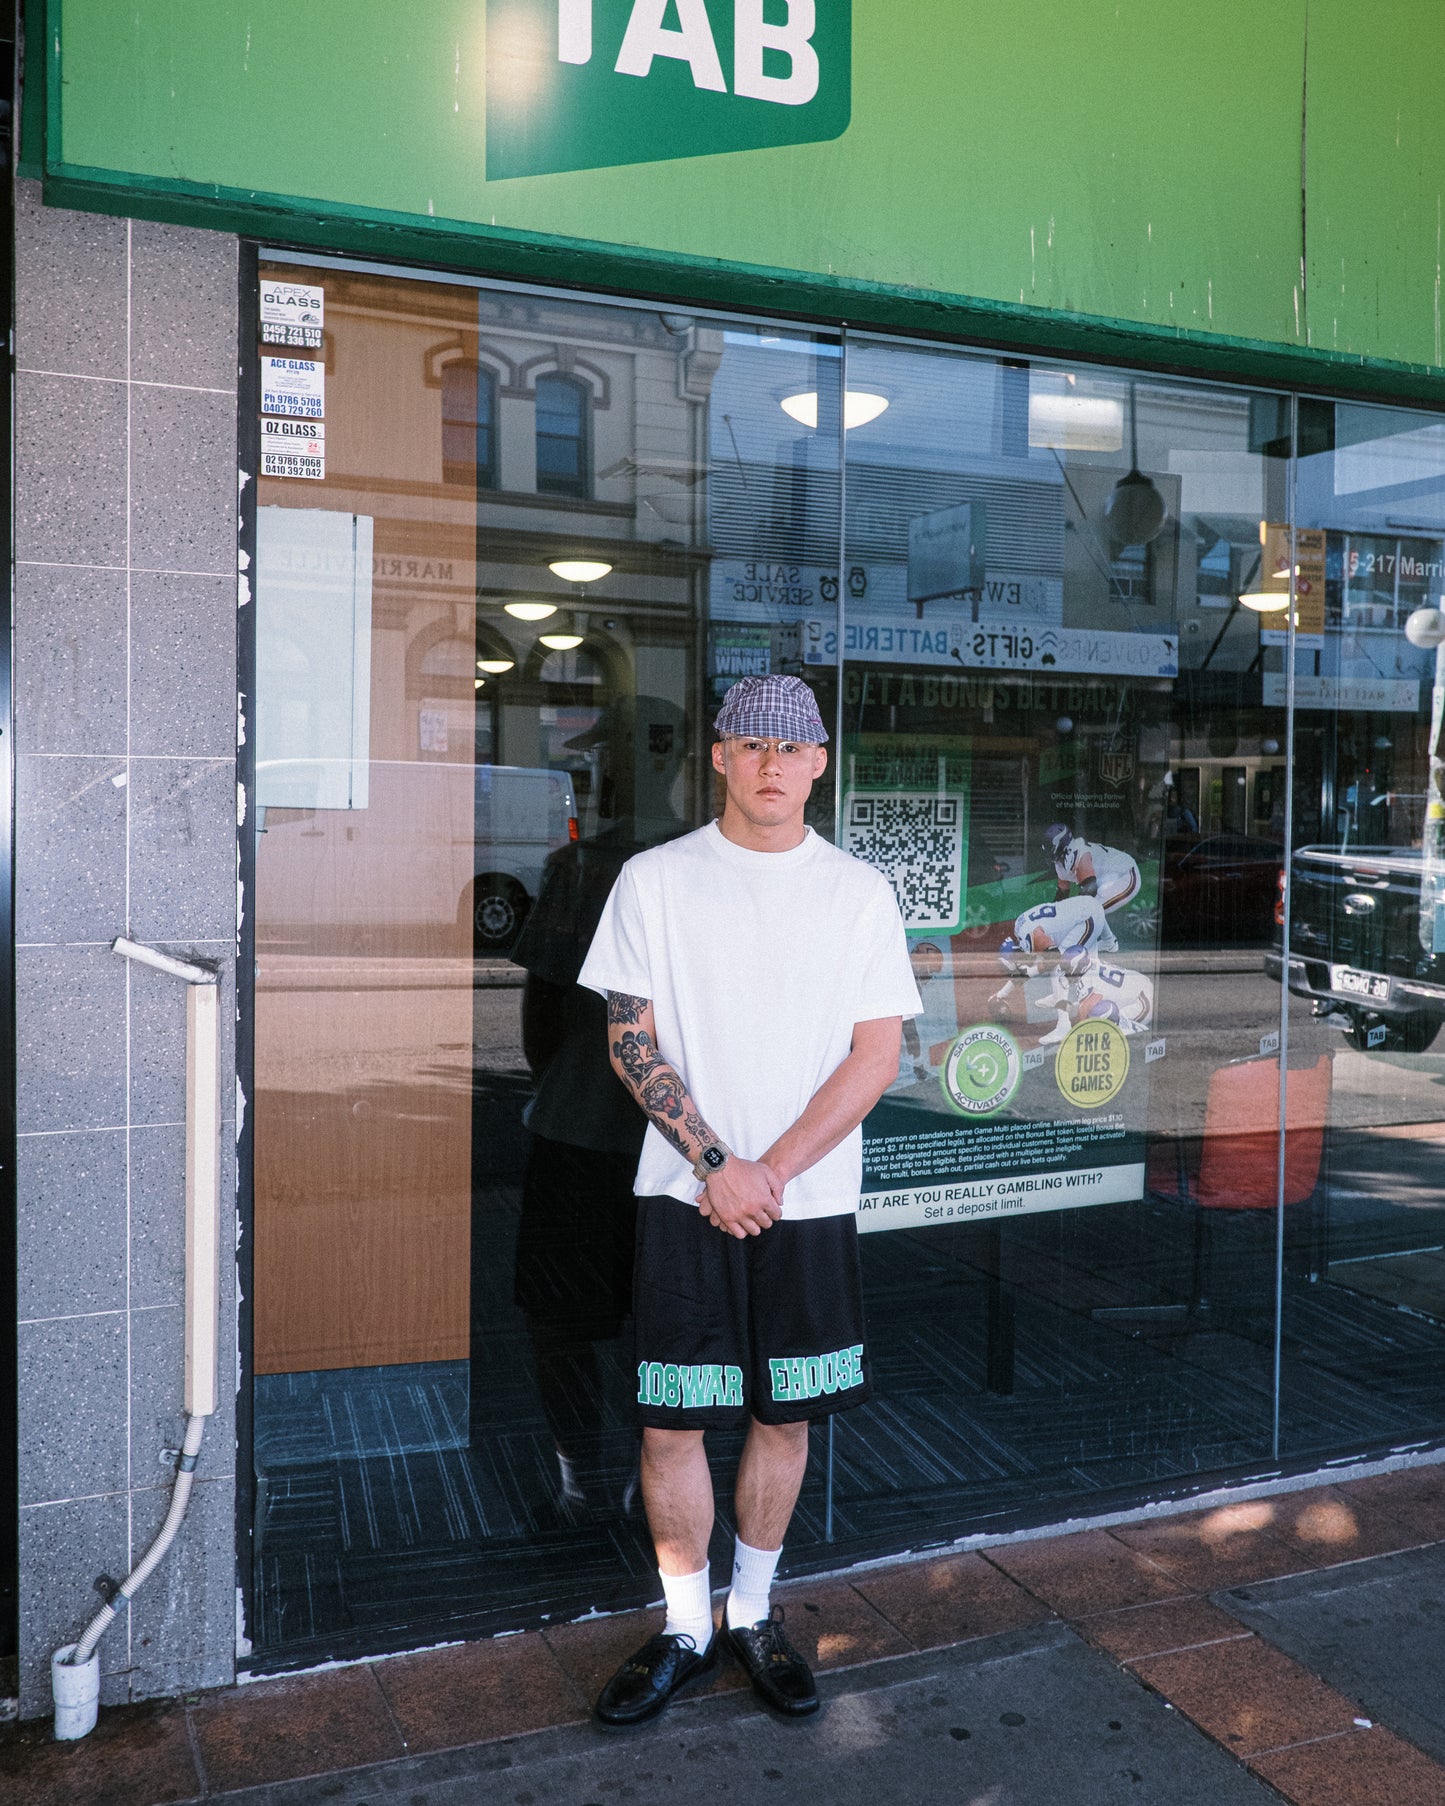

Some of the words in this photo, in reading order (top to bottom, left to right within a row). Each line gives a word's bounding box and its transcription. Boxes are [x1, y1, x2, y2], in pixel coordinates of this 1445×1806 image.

[264, 294, 320, 308] GLASS
[273, 286, 312, 298] APEX
[263, 324, 286, 334] 0456
[288, 326, 303, 336] 721
[304, 328, 321, 338] 510
[263, 333, 286, 344] 0414
[305, 338, 322, 348] 104
[271, 358, 286, 368] ACE
[289, 360, 315, 371] GLASS
[264, 394, 275, 402] Ph
[278, 395, 298, 405] 9786
[300, 397, 322, 407] 5708
[264, 403, 286, 414] 0403
[288, 406, 304, 415] 729
[306, 407, 322, 416] 260
[266, 422, 279, 434] OZ
[282, 423, 316, 437] GLASS
[266, 455, 276, 464] 02
[278, 456, 298, 466] 9786
[300, 458, 321, 468] 9068
[266, 465, 286, 474] 0410
[288, 466, 304, 476] 392
[306, 468, 322, 478] 042
[1401, 556, 1445, 578] Marri
[844, 672, 894, 705] GET
[898, 674, 917, 706] A
[923, 675, 1011, 710] BONUS
[1017, 679, 1061, 711] BET
[1068, 682, 1131, 713] BACK
[1103, 754, 1131, 777] NFL
[954, 1032, 984, 1058] SPORT
[986, 1032, 1012, 1056] SAVER
[1076, 1033, 1098, 1052] FRI
[1101, 1032, 1111, 1050] &
[1263, 1038, 1278, 1048] TAB
[1369, 1030, 1384, 1041] TAB
[1024, 1054, 1042, 1064] TAB
[1147, 1046, 1164, 1055] TAB
[1076, 1053, 1110, 1073] TUES
[1071, 1074, 1112, 1093] GAMES
[954, 1087, 1008, 1109] ACTIVATED
[869, 1146, 886, 1155] price
[905, 1142, 916, 1150] the
[917, 1139, 946, 1149] specified
[976, 1134, 1004, 1144] allocated
[1014, 1132, 1024, 1140] the
[1026, 1131, 1044, 1139] Bonus
[1096, 1124, 1114, 1132] Bonus
[872, 1138, 883, 1146] per
[885, 1136, 908, 1146] person
[919, 1130, 954, 1140] standalone
[955, 1129, 972, 1137] Same
[1010, 1123, 1030, 1132] placed
[1054, 1118, 1081, 1127] Minimum
[1092, 1116, 1108, 1124] price
[872, 1156, 880, 1164] up
[896, 1150, 932, 1160] designated
[932, 1148, 956, 1156] amount
[958, 1144, 982, 1154] specific
[992, 1140, 1020, 1150] individual
[1056, 1136, 1074, 1144] Token
[1100, 1131, 1126, 1140] activated
[866, 1164, 872, 1172] in
[874, 1164, 888, 1172] your
[890, 1162, 900, 1170] bet
[902, 1160, 913, 1168] slip
[923, 1158, 932, 1166] be
[958, 1154, 972, 1162] Bets
[974, 1152, 994, 1162] placed
[996, 1151, 1010, 1159] with
[1016, 1148, 1044, 1158] multiplier
[880, 1172, 890, 1180] No
[934, 1166, 949, 1174] cash
[964, 1162, 984, 1172] partial
[1001, 1160, 1011, 1168] out
[1032, 1156, 1046, 1164] bets
[882, 1194, 909, 1209] ARE
[913, 1190, 941, 1204] YOU
[946, 1184, 994, 1201] REALLY
[997, 1178, 1062, 1195] GAMBLING
[1065, 1172, 1103, 1188] WITH?
[924, 1206, 944, 1219] Set
[946, 1208, 954, 1216] a
[957, 1200, 998, 1217] deposit
[1001, 1196, 1026, 1210] limit.
[768, 1343, 864, 1401] EHOUSE
[637, 1360, 744, 1409] 108WAR
